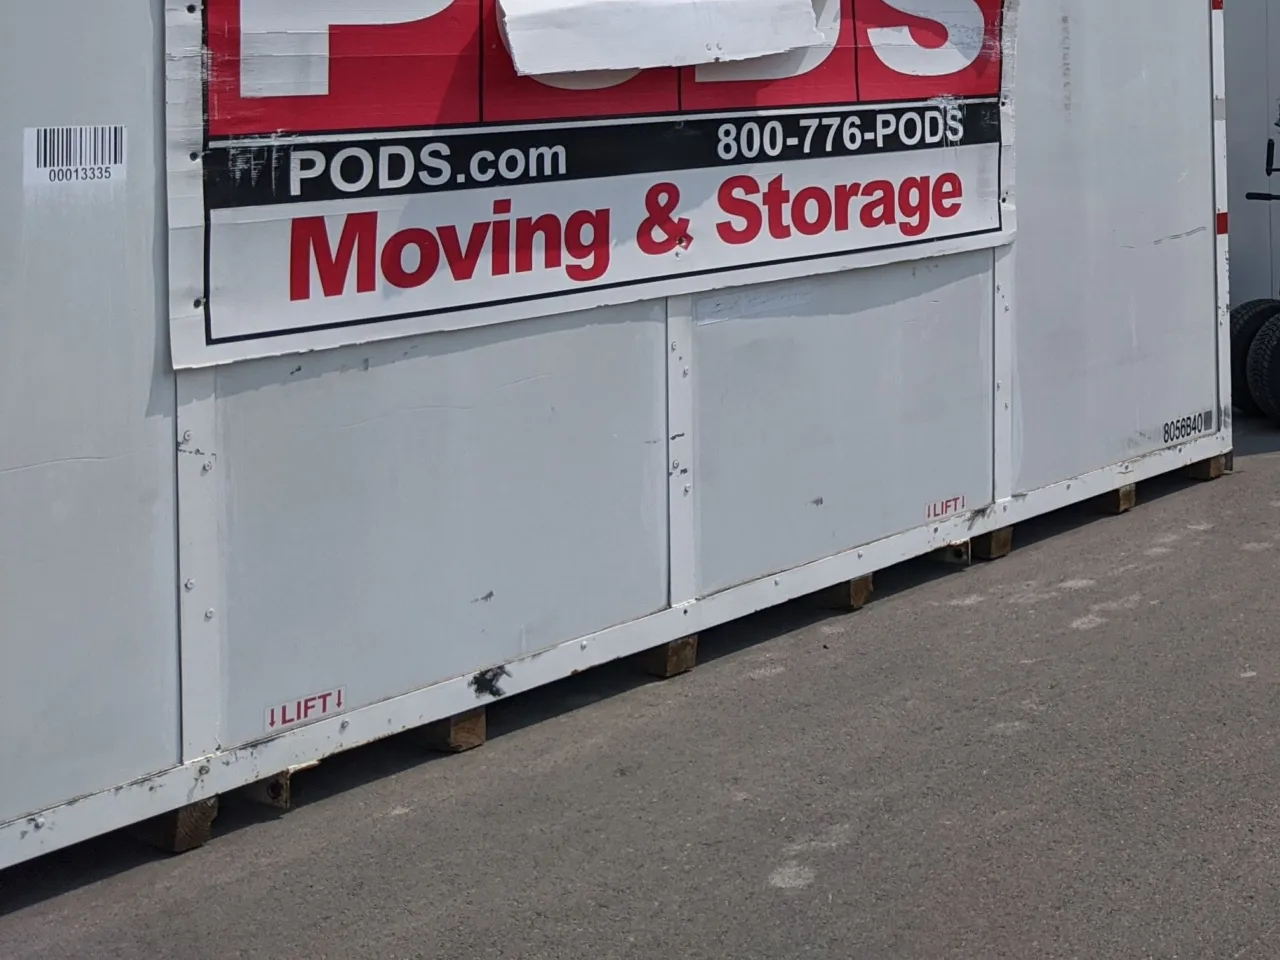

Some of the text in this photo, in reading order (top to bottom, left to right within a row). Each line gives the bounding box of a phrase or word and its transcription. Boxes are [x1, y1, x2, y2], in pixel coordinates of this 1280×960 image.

[716, 107, 965, 161] 800-776-PODS
[49, 167, 111, 182] 00013335
[289, 142, 567, 197] PODS.com
[289, 171, 963, 303] Moving & Storage
[1163, 413, 1203, 444] 8056B40
[933, 497, 959, 517] LIFT
[281, 692, 332, 725] LIFT
